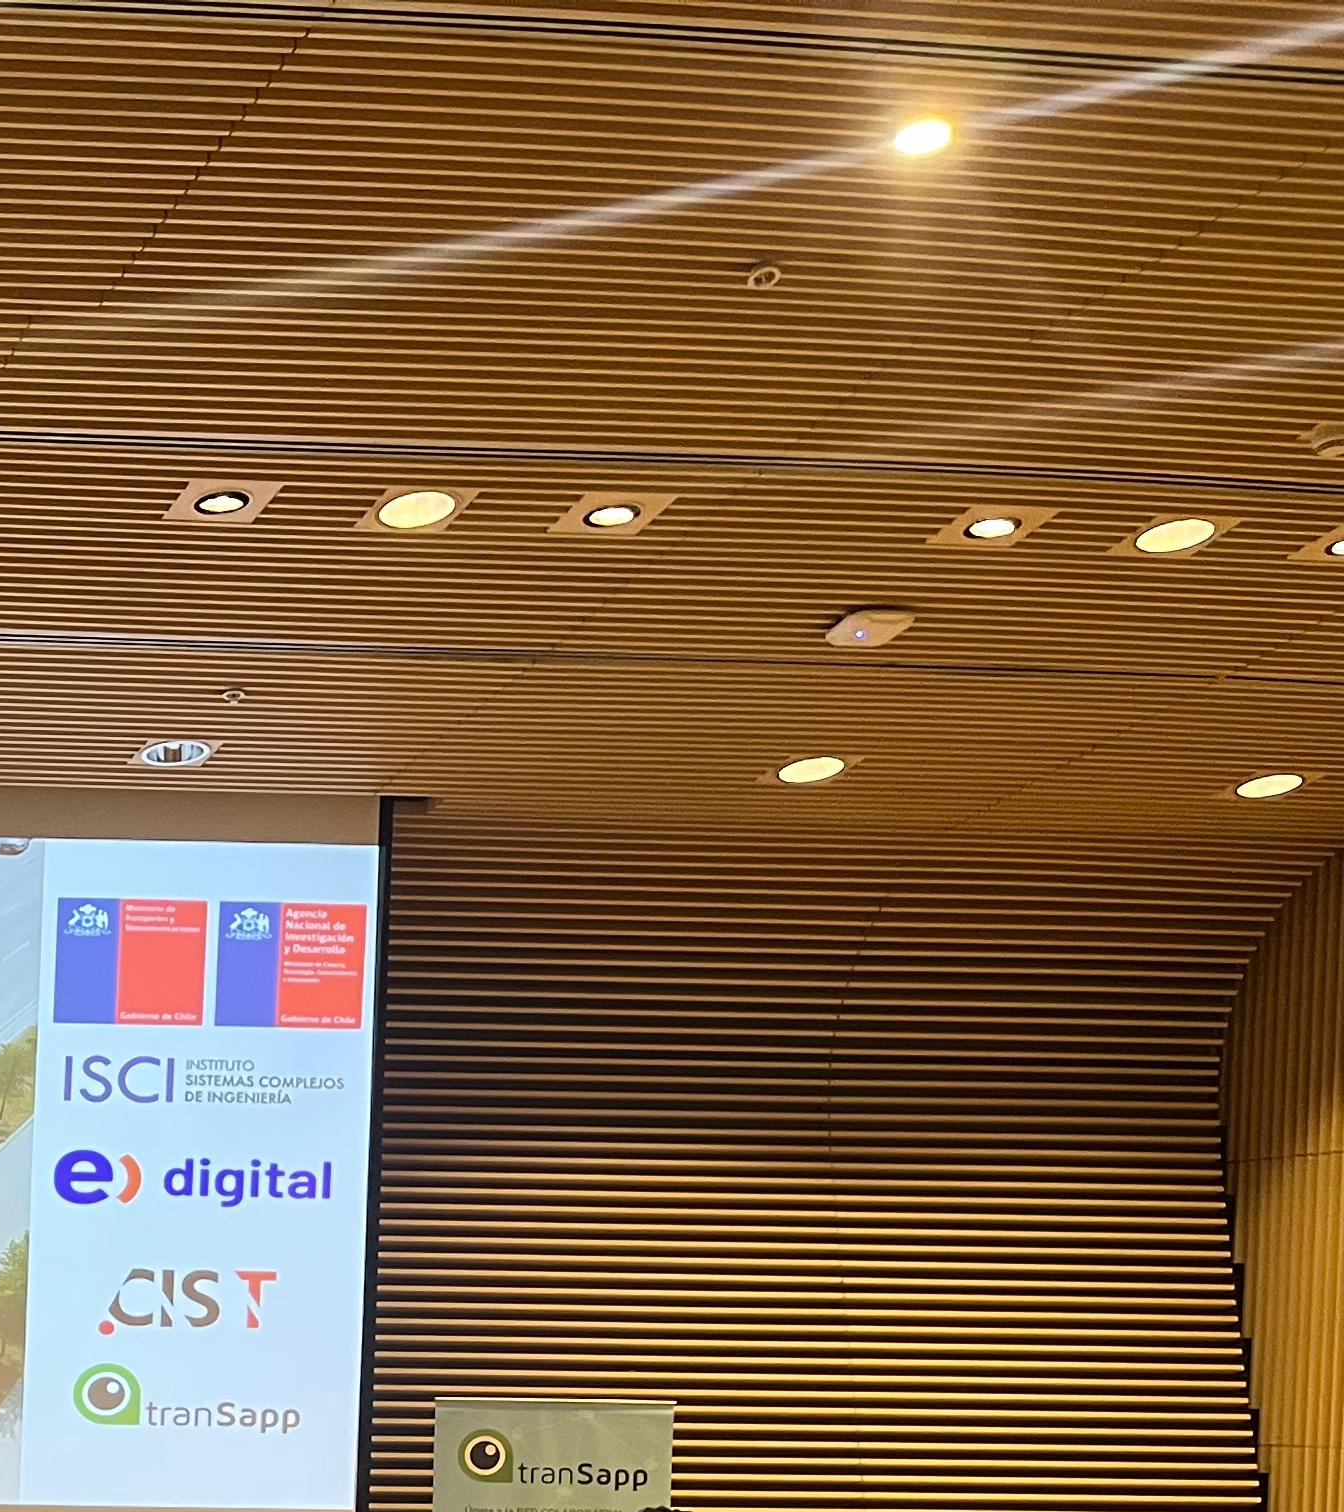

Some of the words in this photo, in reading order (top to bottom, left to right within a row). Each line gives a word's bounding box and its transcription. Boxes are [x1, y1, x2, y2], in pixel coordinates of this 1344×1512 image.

[285, 908, 328, 920] Agencia
[285, 920, 331, 930] Nacional
[332, 921, 347, 931] de
[285, 931, 354, 944] Investigación
[283, 945, 291, 956] y
[292, 943, 346, 954] Desarrollo
[185, 1059, 255, 1072] INSTITUTO
[63, 1055, 175, 1104] ISCI
[185, 1074, 254, 1088] SISTEMAS
[258, 1076, 345, 1090] COMPLEJOS
[184, 1091, 203, 1103] DE
[207, 1089, 292, 1105] INGENIERÍA
[163, 1157, 332, 1208] digital
[146, 1402, 301, 1434] tranSapp
[517, 1462, 649, 1491] tranSapp
